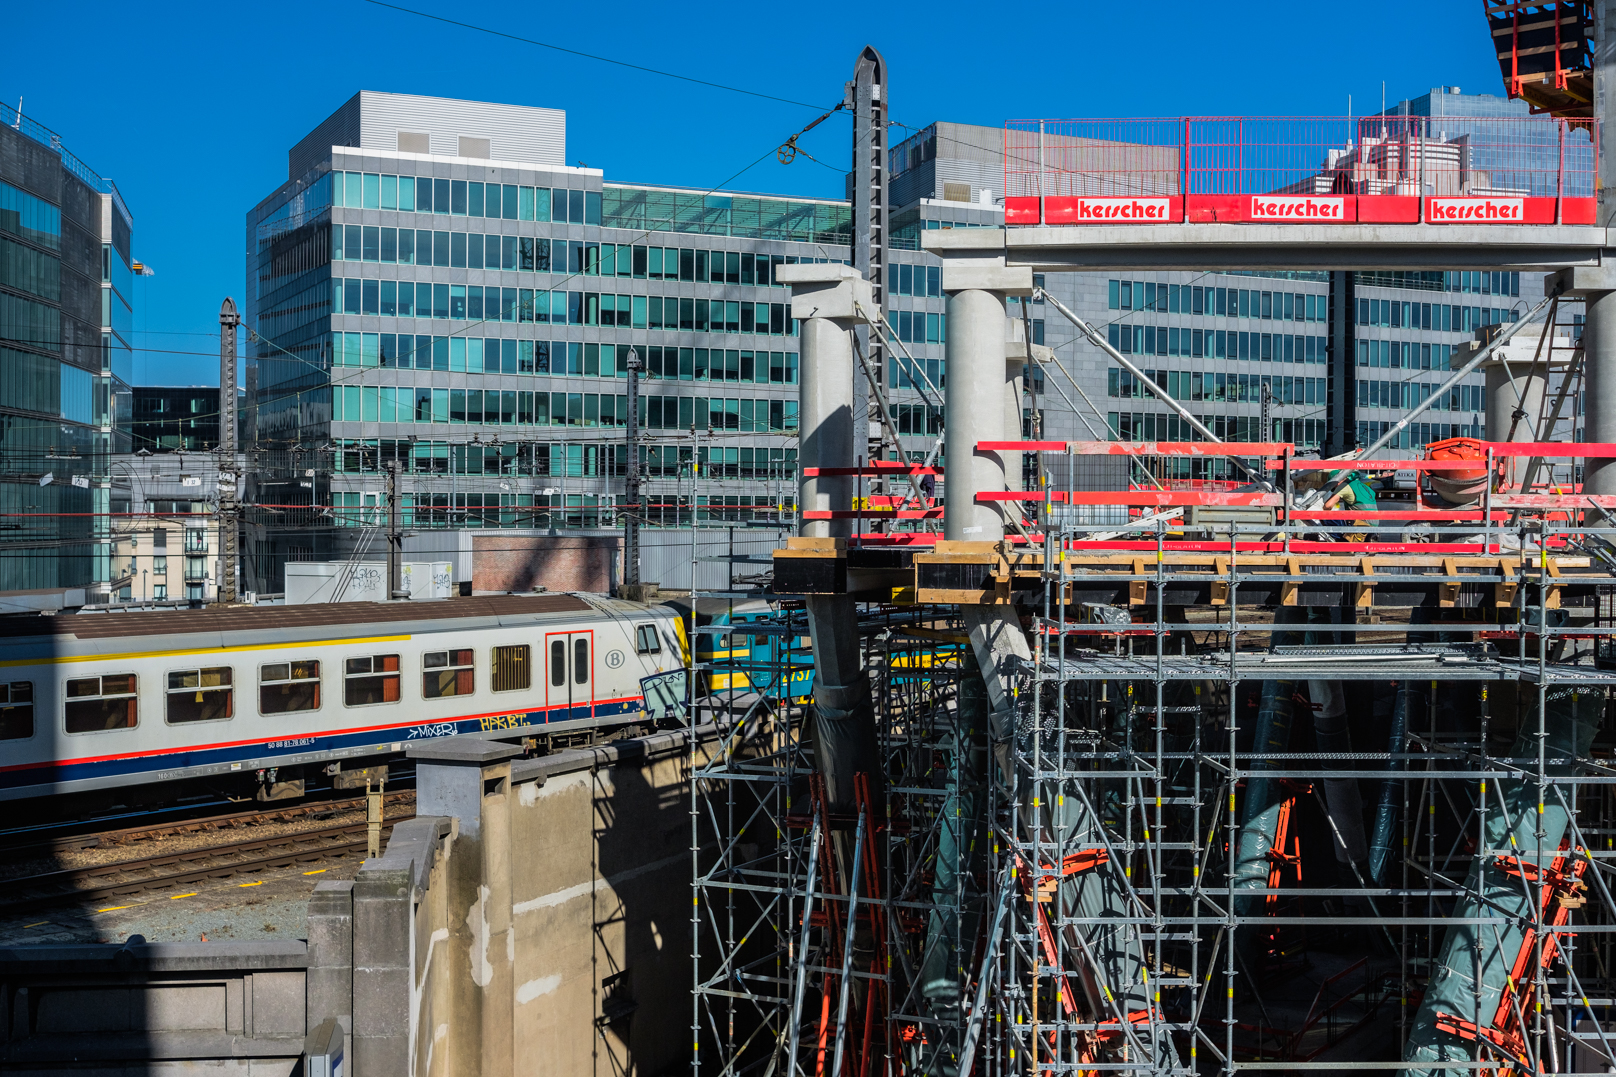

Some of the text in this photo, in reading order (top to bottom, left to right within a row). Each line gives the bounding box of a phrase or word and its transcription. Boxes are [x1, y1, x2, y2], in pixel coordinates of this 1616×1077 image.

[1080, 200, 1165, 218] kerscher
[1253, 198, 1339, 217] kerscher
[1433, 201, 1519, 219] kerscher
